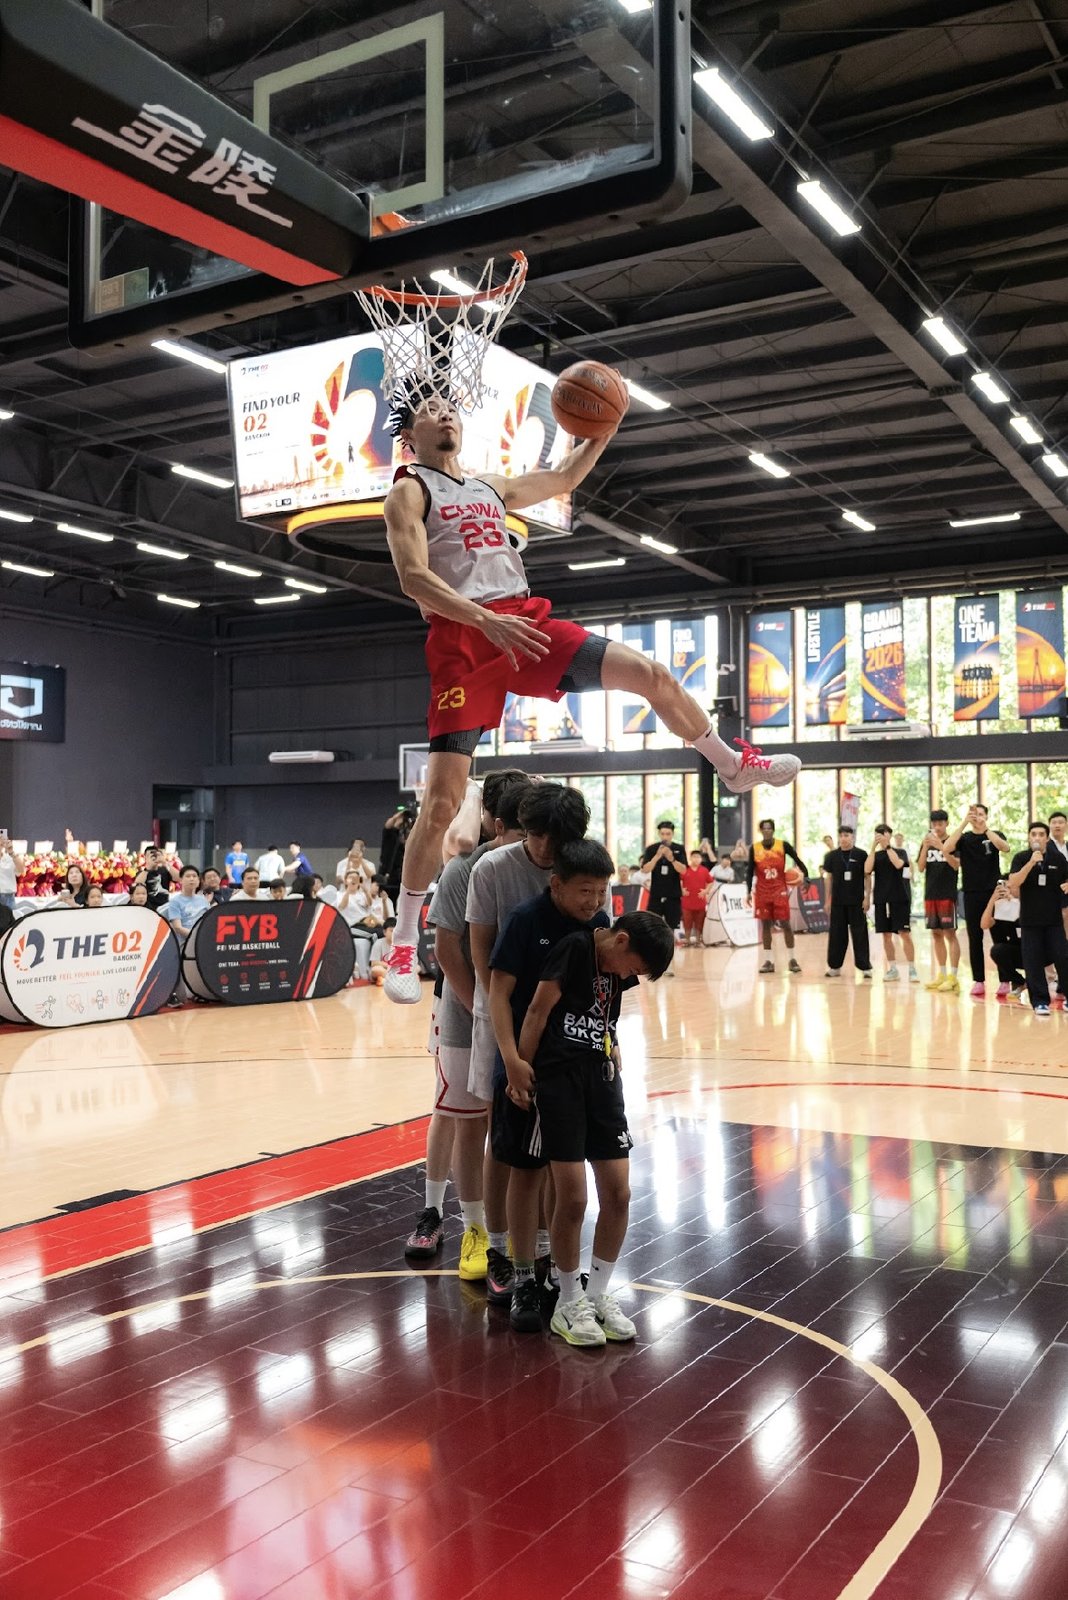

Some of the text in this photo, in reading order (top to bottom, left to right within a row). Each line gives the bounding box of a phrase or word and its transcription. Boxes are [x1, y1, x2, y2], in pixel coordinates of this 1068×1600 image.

[71, 102, 293, 229] 金陵
[243, 392, 301, 413] FIND YOUR
[243, 413, 268, 433] 02
[459, 521, 505, 552] 23
[863, 607, 902, 633] GRAND
[958, 604, 986, 625] ONE
[959, 621, 995, 643] TEAM
[437, 686, 466, 710] 23
[216, 913, 279, 943] FYB
[53, 930, 143, 960] THE 02
[242, 941, 281, 950] BASKETBALL
[113, 954, 142, 962] BANGKOK
[16, 977, 34, 985] MOVE
